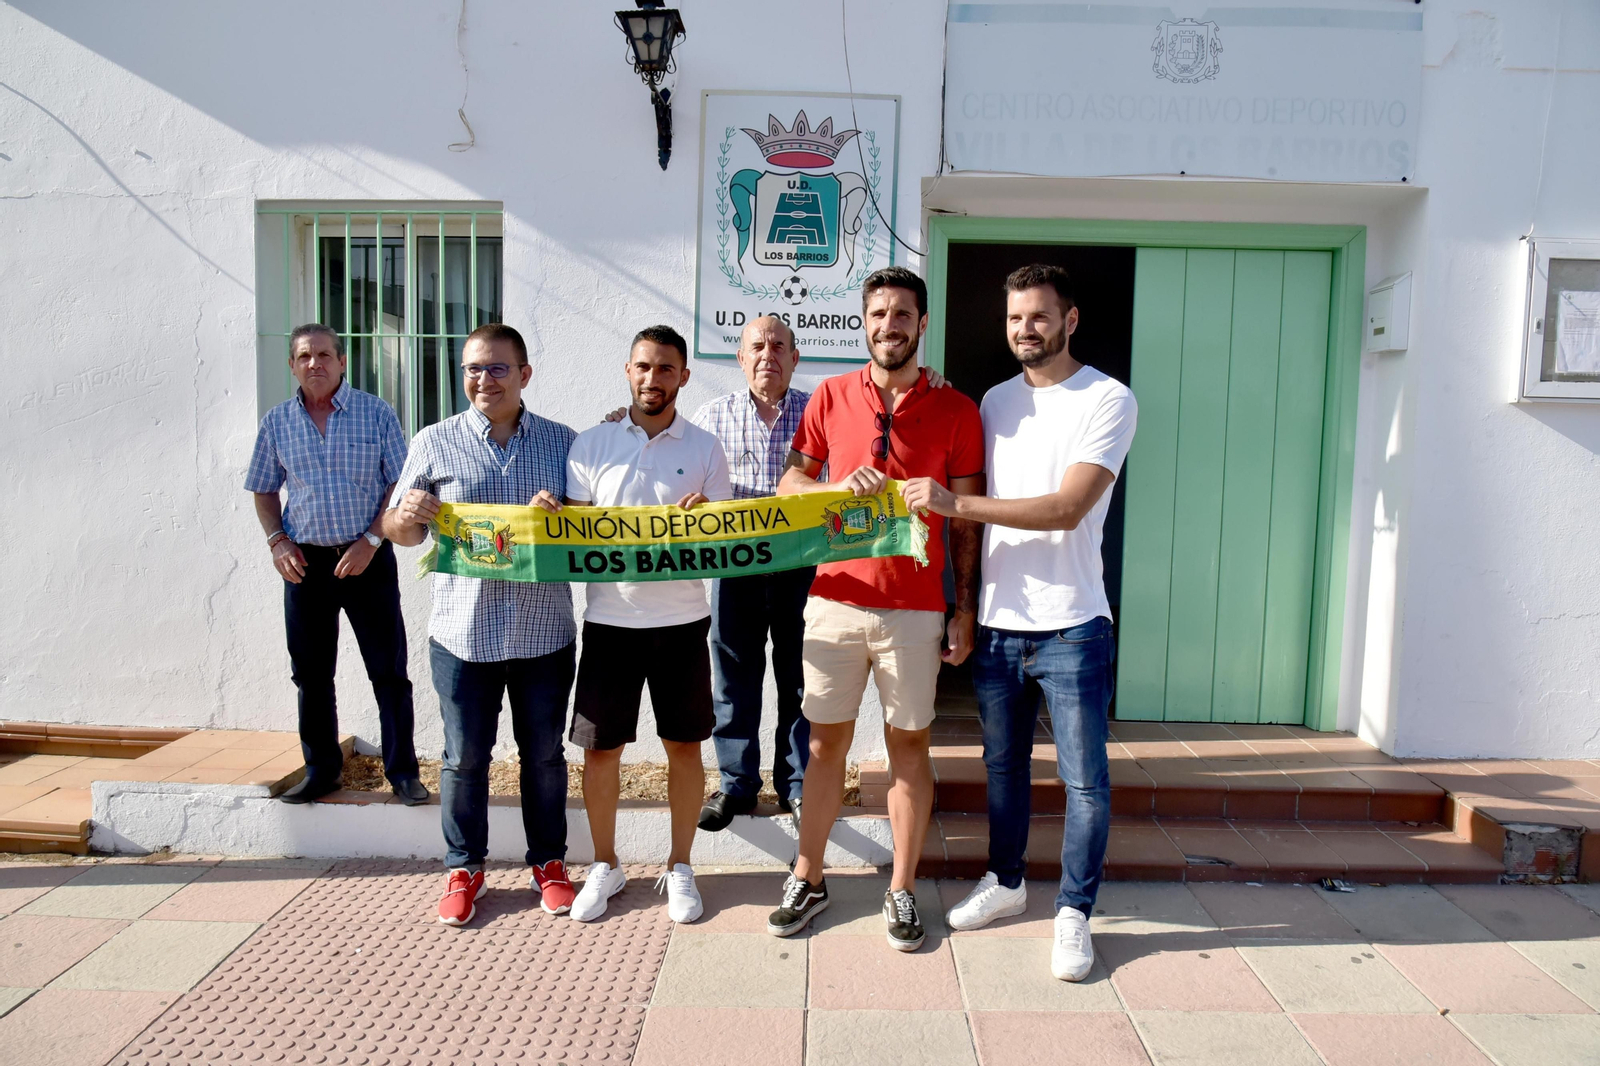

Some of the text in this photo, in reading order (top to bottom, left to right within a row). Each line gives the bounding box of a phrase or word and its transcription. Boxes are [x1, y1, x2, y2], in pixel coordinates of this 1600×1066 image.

[961, 91, 1407, 128] CENTRO ASOCIATIVO DEPORTIVO
[787, 180, 812, 190] U.D.
[764, 251, 829, 262] LOS BARRIOS
[715, 311, 749, 327] U.D
[797, 313, 866, 331] BARRIO
[544, 506, 791, 540] UNIÓN DEPORTIVA
[567, 541, 774, 574] LOS BARRIOS
